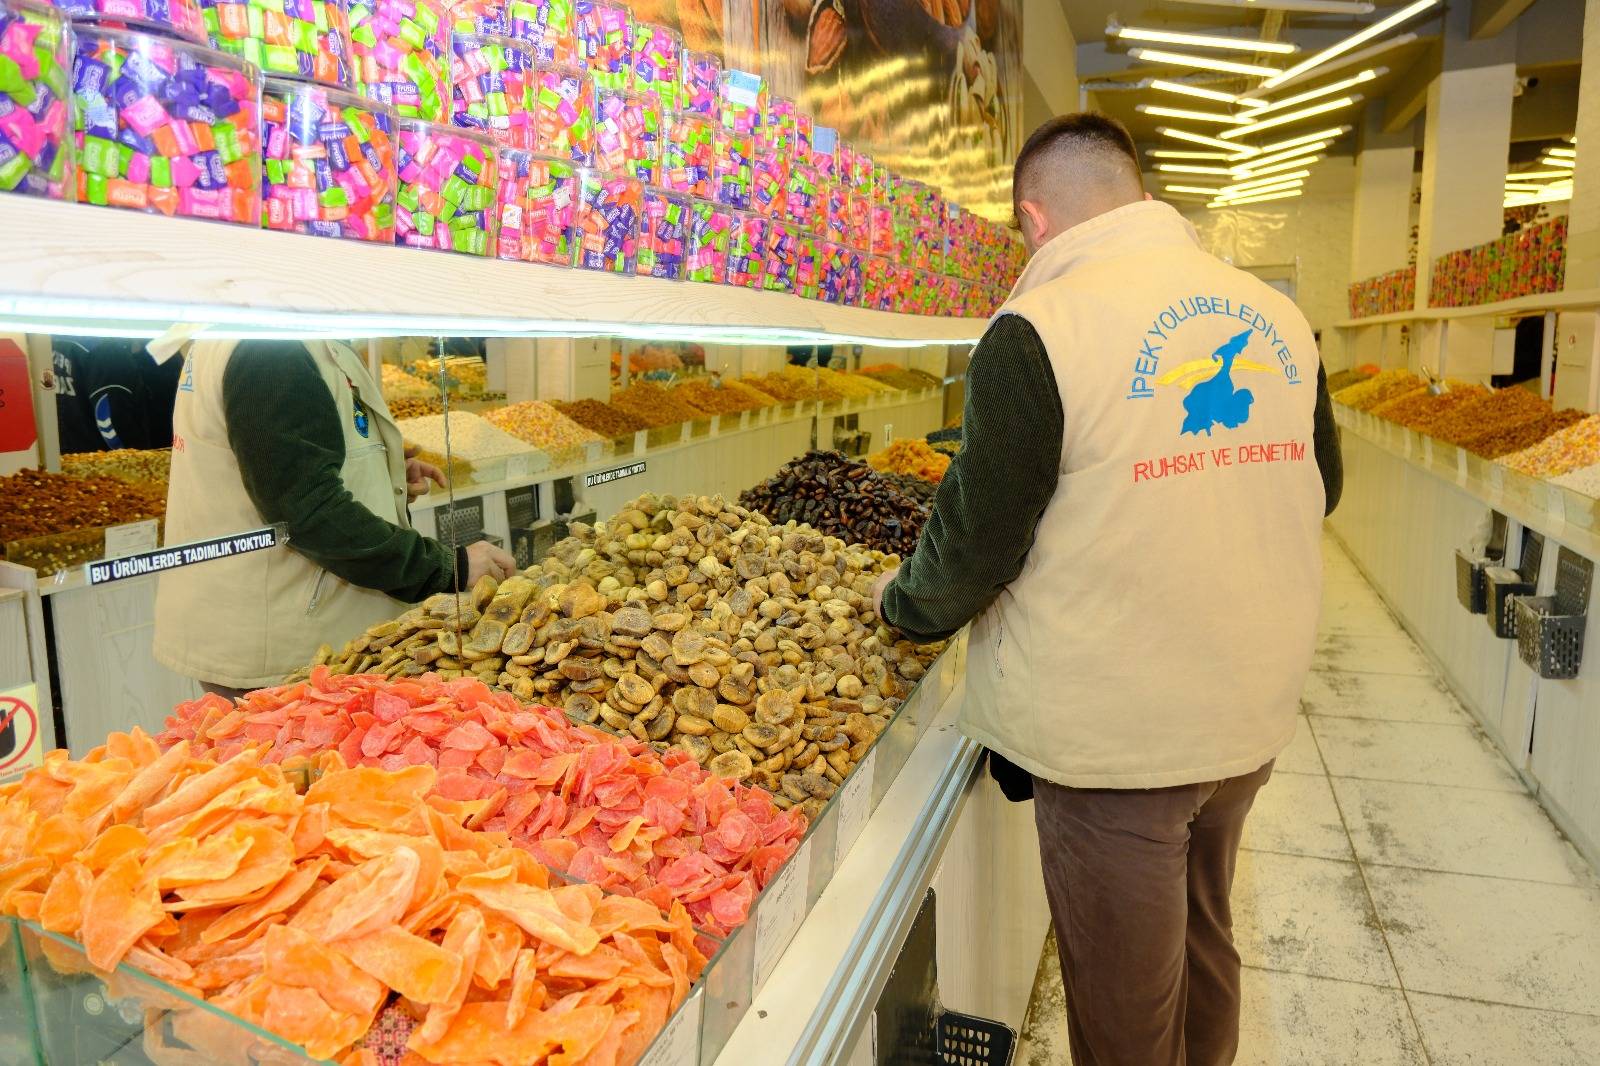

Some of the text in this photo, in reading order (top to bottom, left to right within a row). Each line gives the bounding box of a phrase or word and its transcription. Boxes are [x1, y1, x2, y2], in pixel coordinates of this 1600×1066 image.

[1134, 440, 1306, 482] RUHSAT VE DENETİM
[92, 533, 275, 583] BU ÜRÜNLERDE TADIMLIK YOKTUR.
